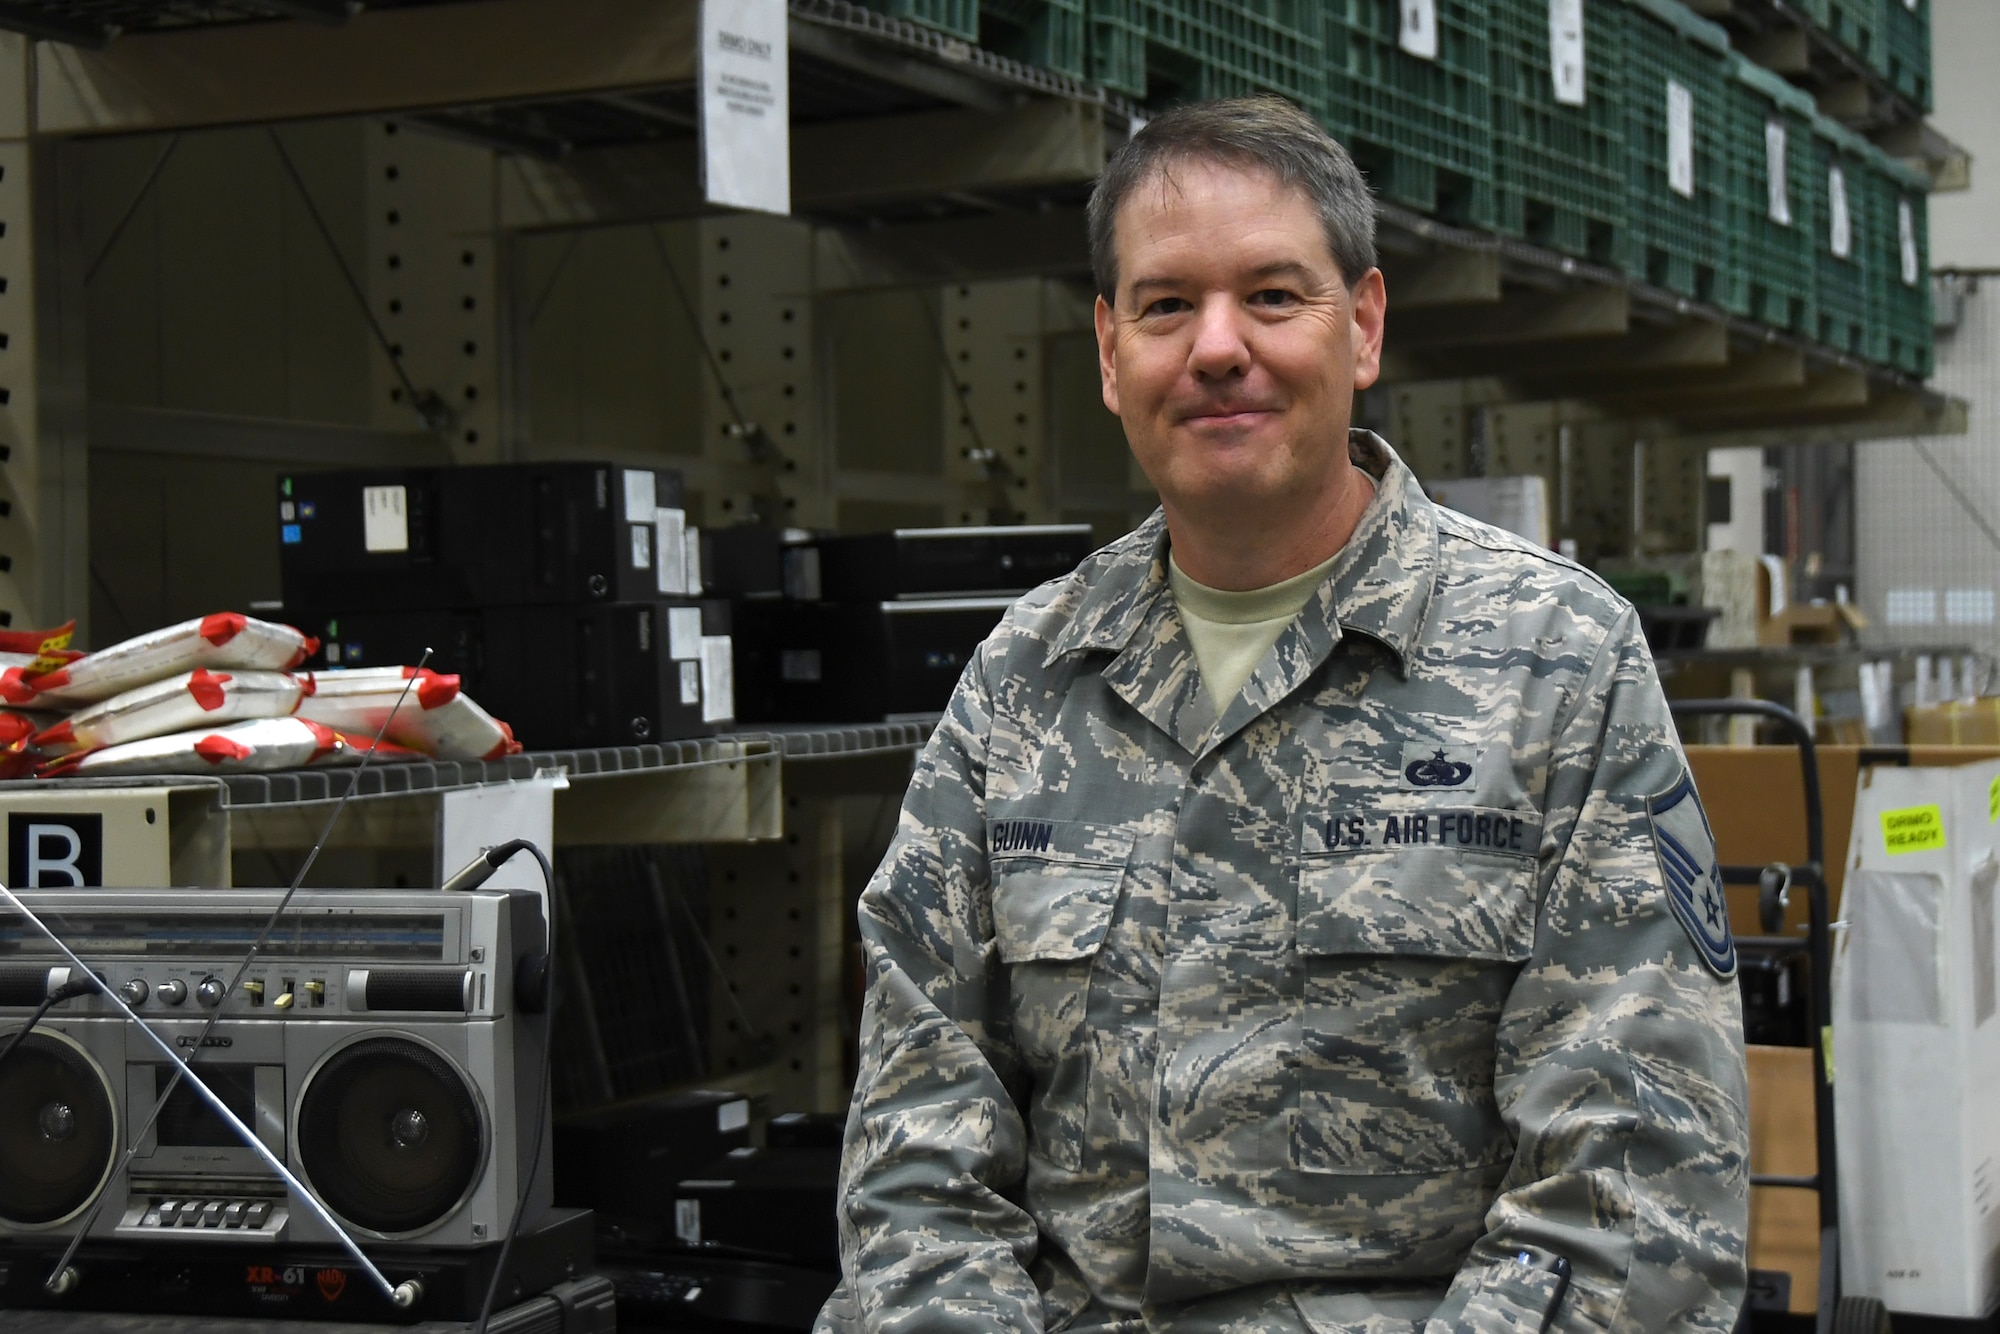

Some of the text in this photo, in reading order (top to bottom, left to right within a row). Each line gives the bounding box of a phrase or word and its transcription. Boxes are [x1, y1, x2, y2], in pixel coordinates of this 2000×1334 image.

[993, 821, 1053, 853] GUINN
[1325, 813, 1523, 849] U.S. AIR FORCE
[1886, 828, 1938, 846] READY
[247, 1267, 304, 1284] XR-61
